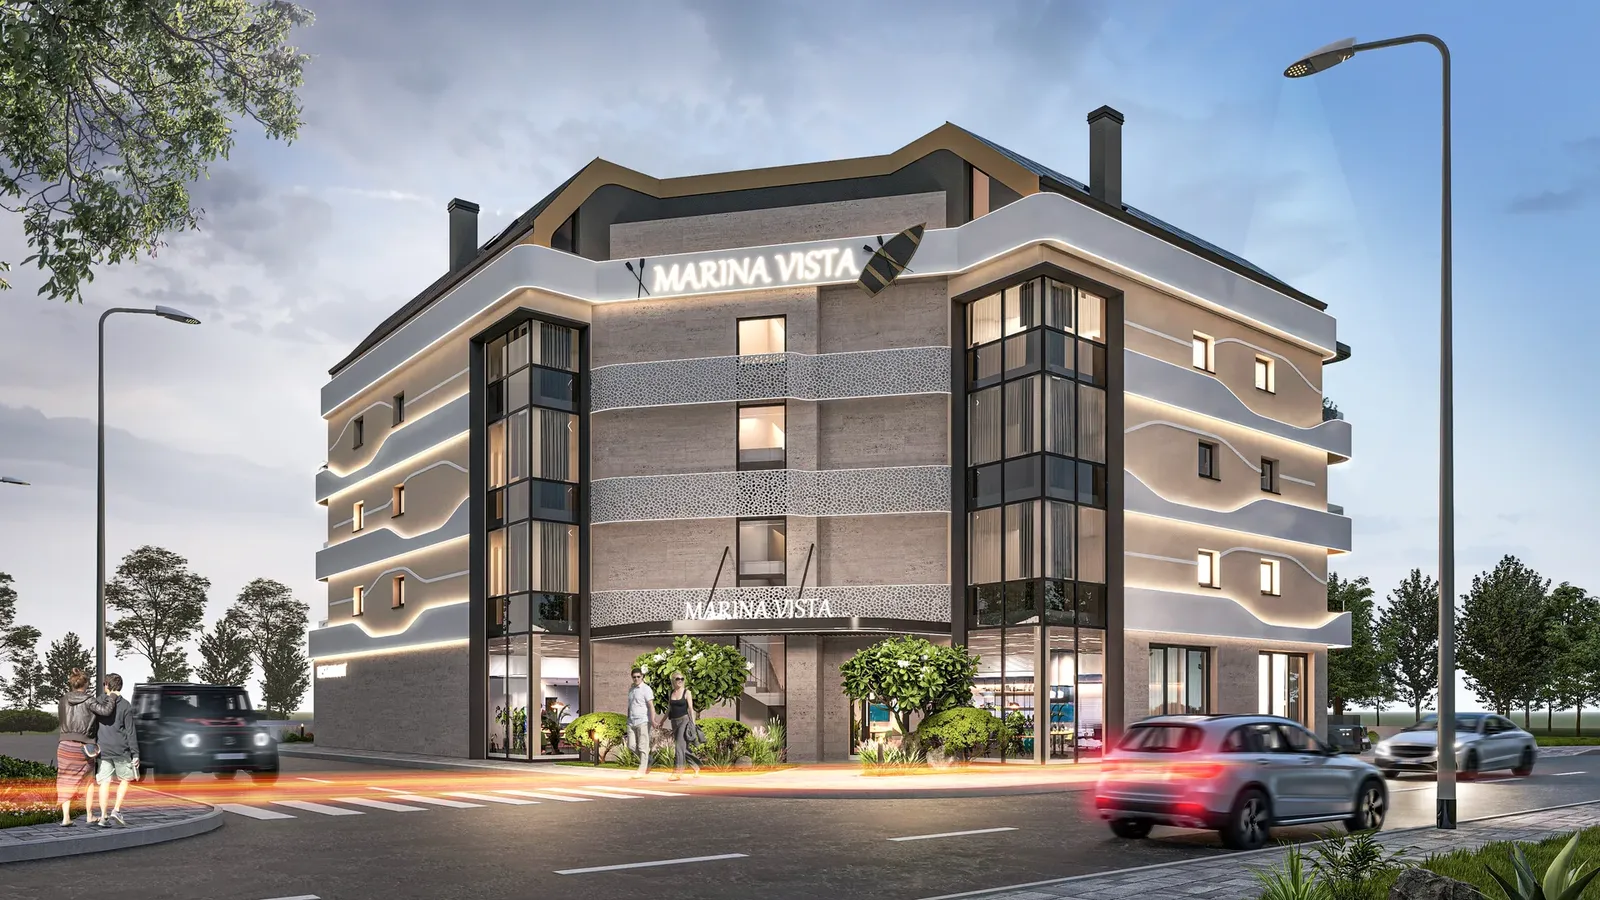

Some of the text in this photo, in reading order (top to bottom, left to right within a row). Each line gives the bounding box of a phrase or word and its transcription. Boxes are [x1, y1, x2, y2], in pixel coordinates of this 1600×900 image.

[654, 248, 860, 292] MARINA VISTA
[685, 599, 834, 620] MARINA VISTA
